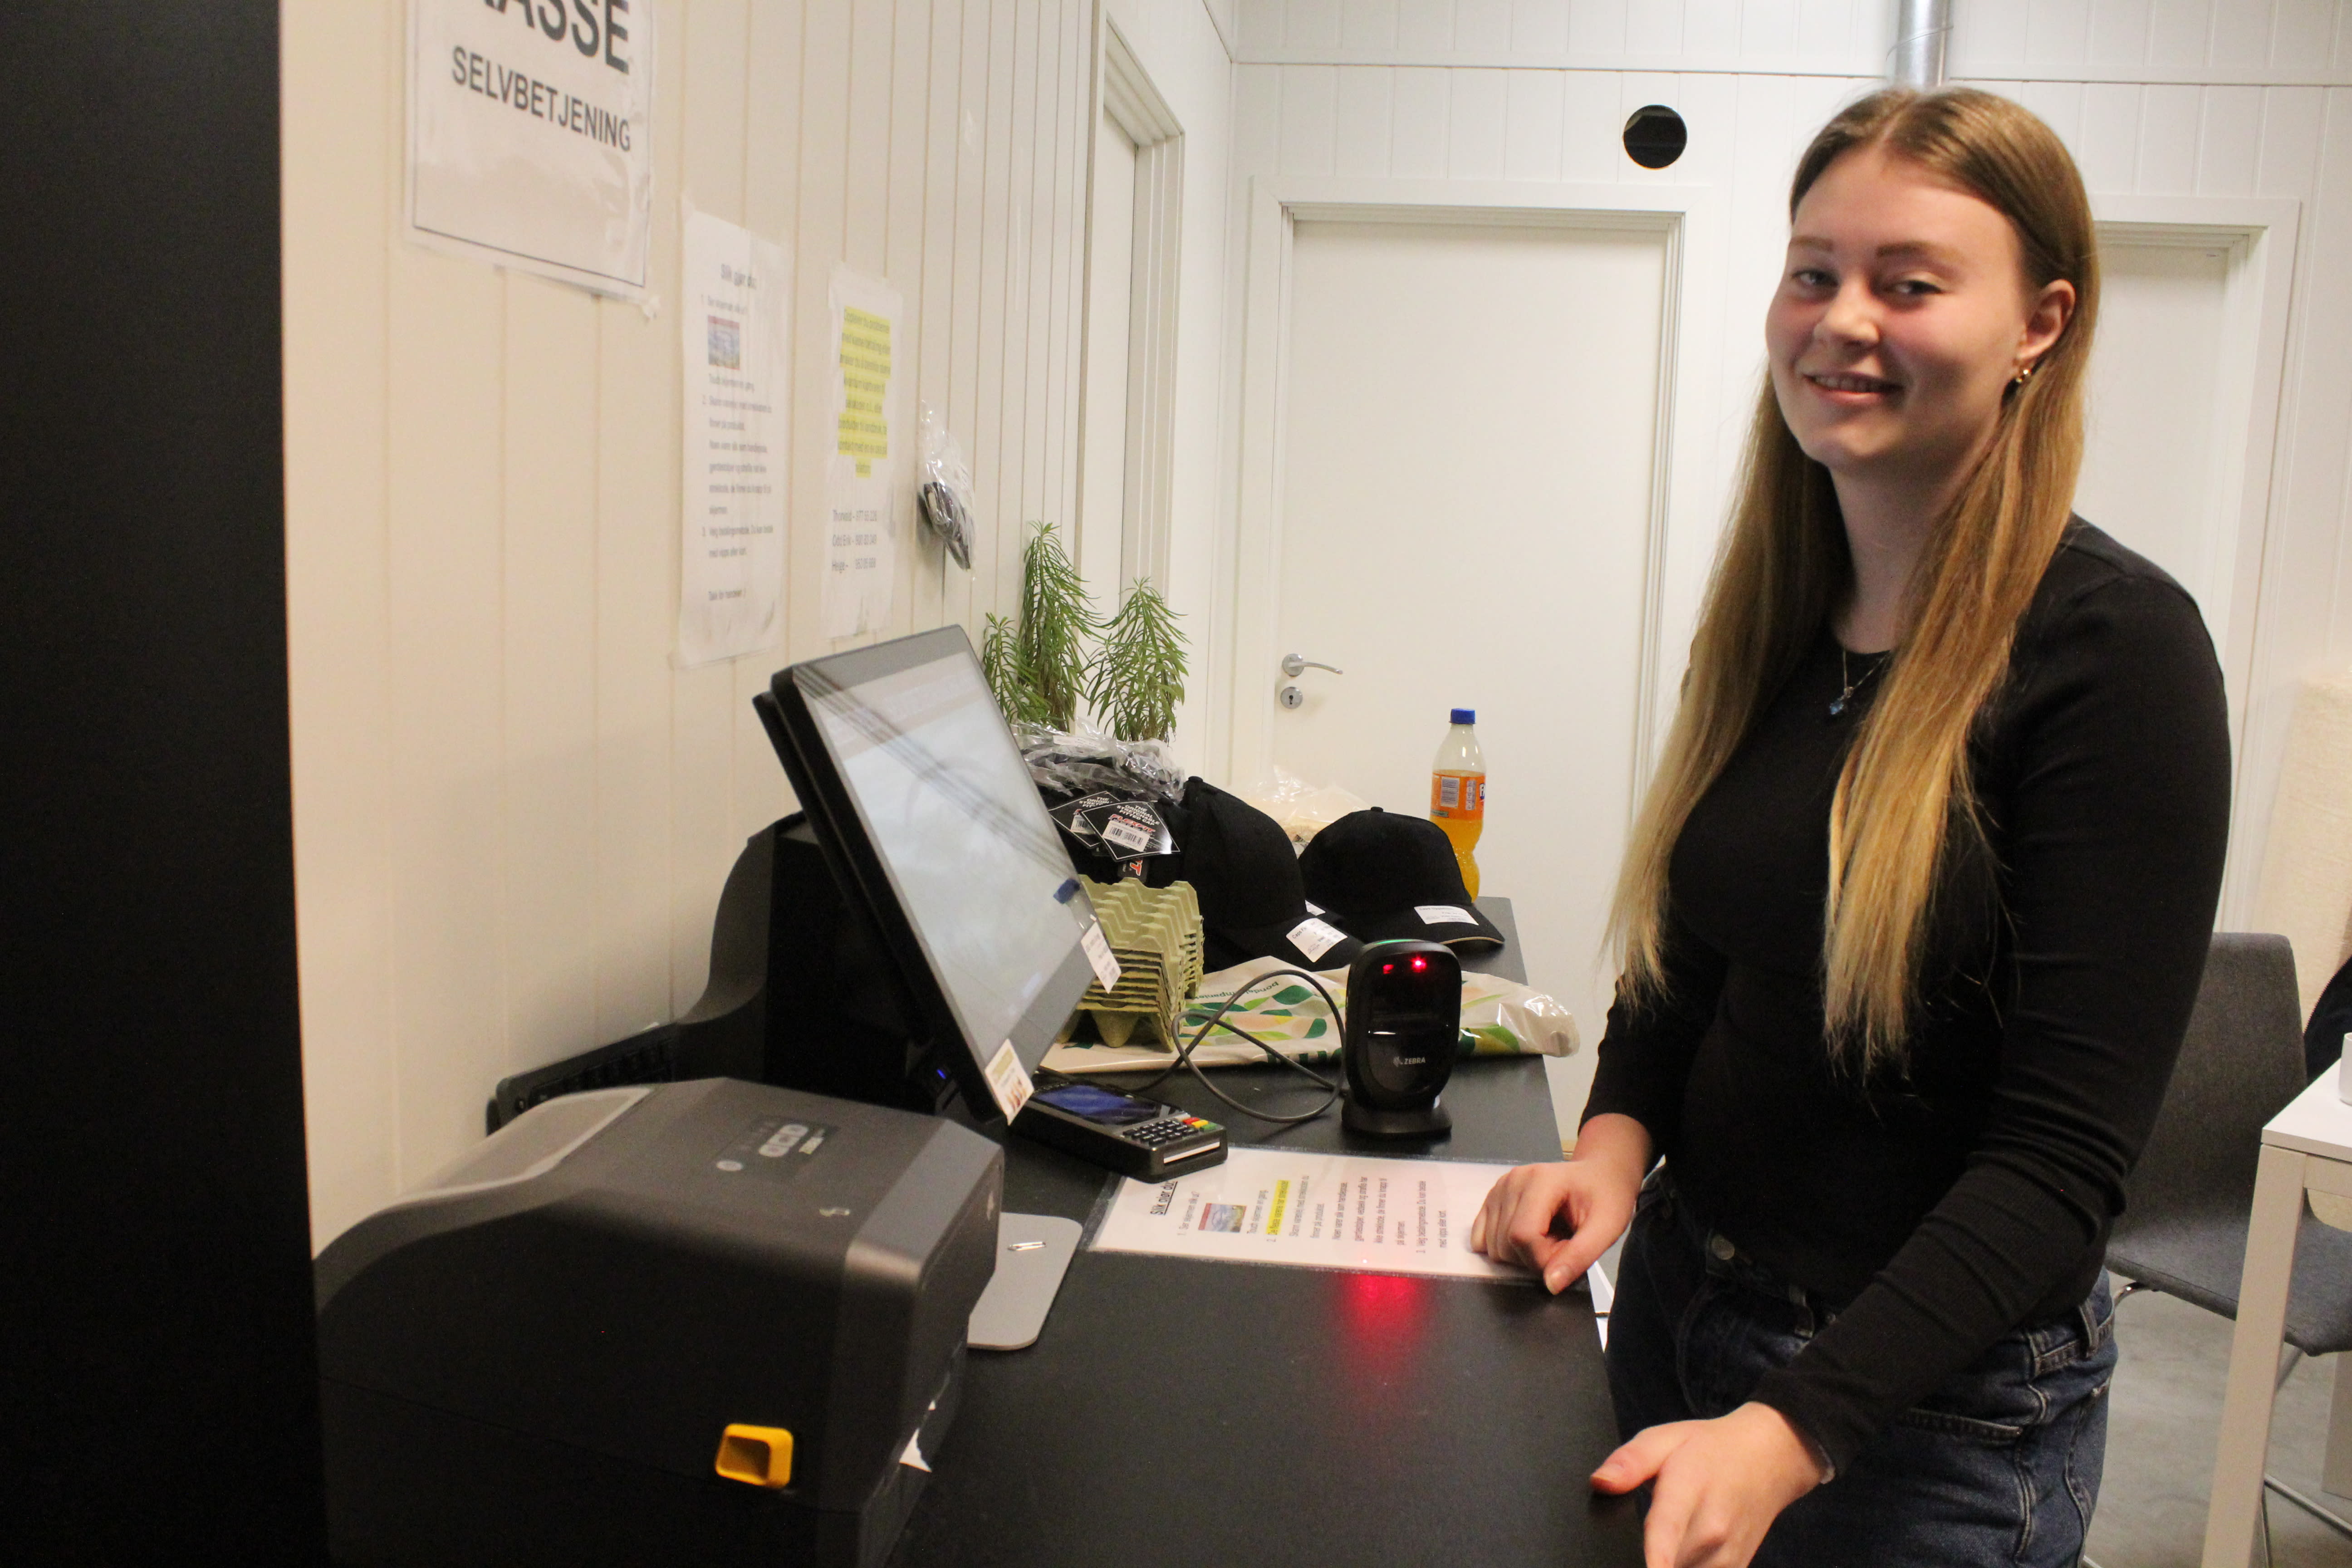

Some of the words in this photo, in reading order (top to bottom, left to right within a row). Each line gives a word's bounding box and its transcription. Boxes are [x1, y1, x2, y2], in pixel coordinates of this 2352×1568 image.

[485, 0, 630, 74] SSE
[452, 45, 631, 151] SELVBETJENING
[1117, 805, 1160, 825] STRETCHABLE
[1119, 809, 1142, 820] FITTED
[1125, 804, 1153, 818] ORIGINAL
[1292, 931, 1302, 939] Caps
[1156, 1191, 1171, 1203] gjør
[1150, 1204, 1166, 1215] Slik
[1183, 1205, 1195, 1222] skjermen
[1251, 1205, 1263, 1221] skjermen
[1246, 1222, 1258, 1234] Touch
[1310, 1227, 1321, 1238] finner
[1332, 1229, 1342, 1240] Noen
[1416, 1237, 1428, 1246] Velg
[1438, 1239, 1447, 1248] med
